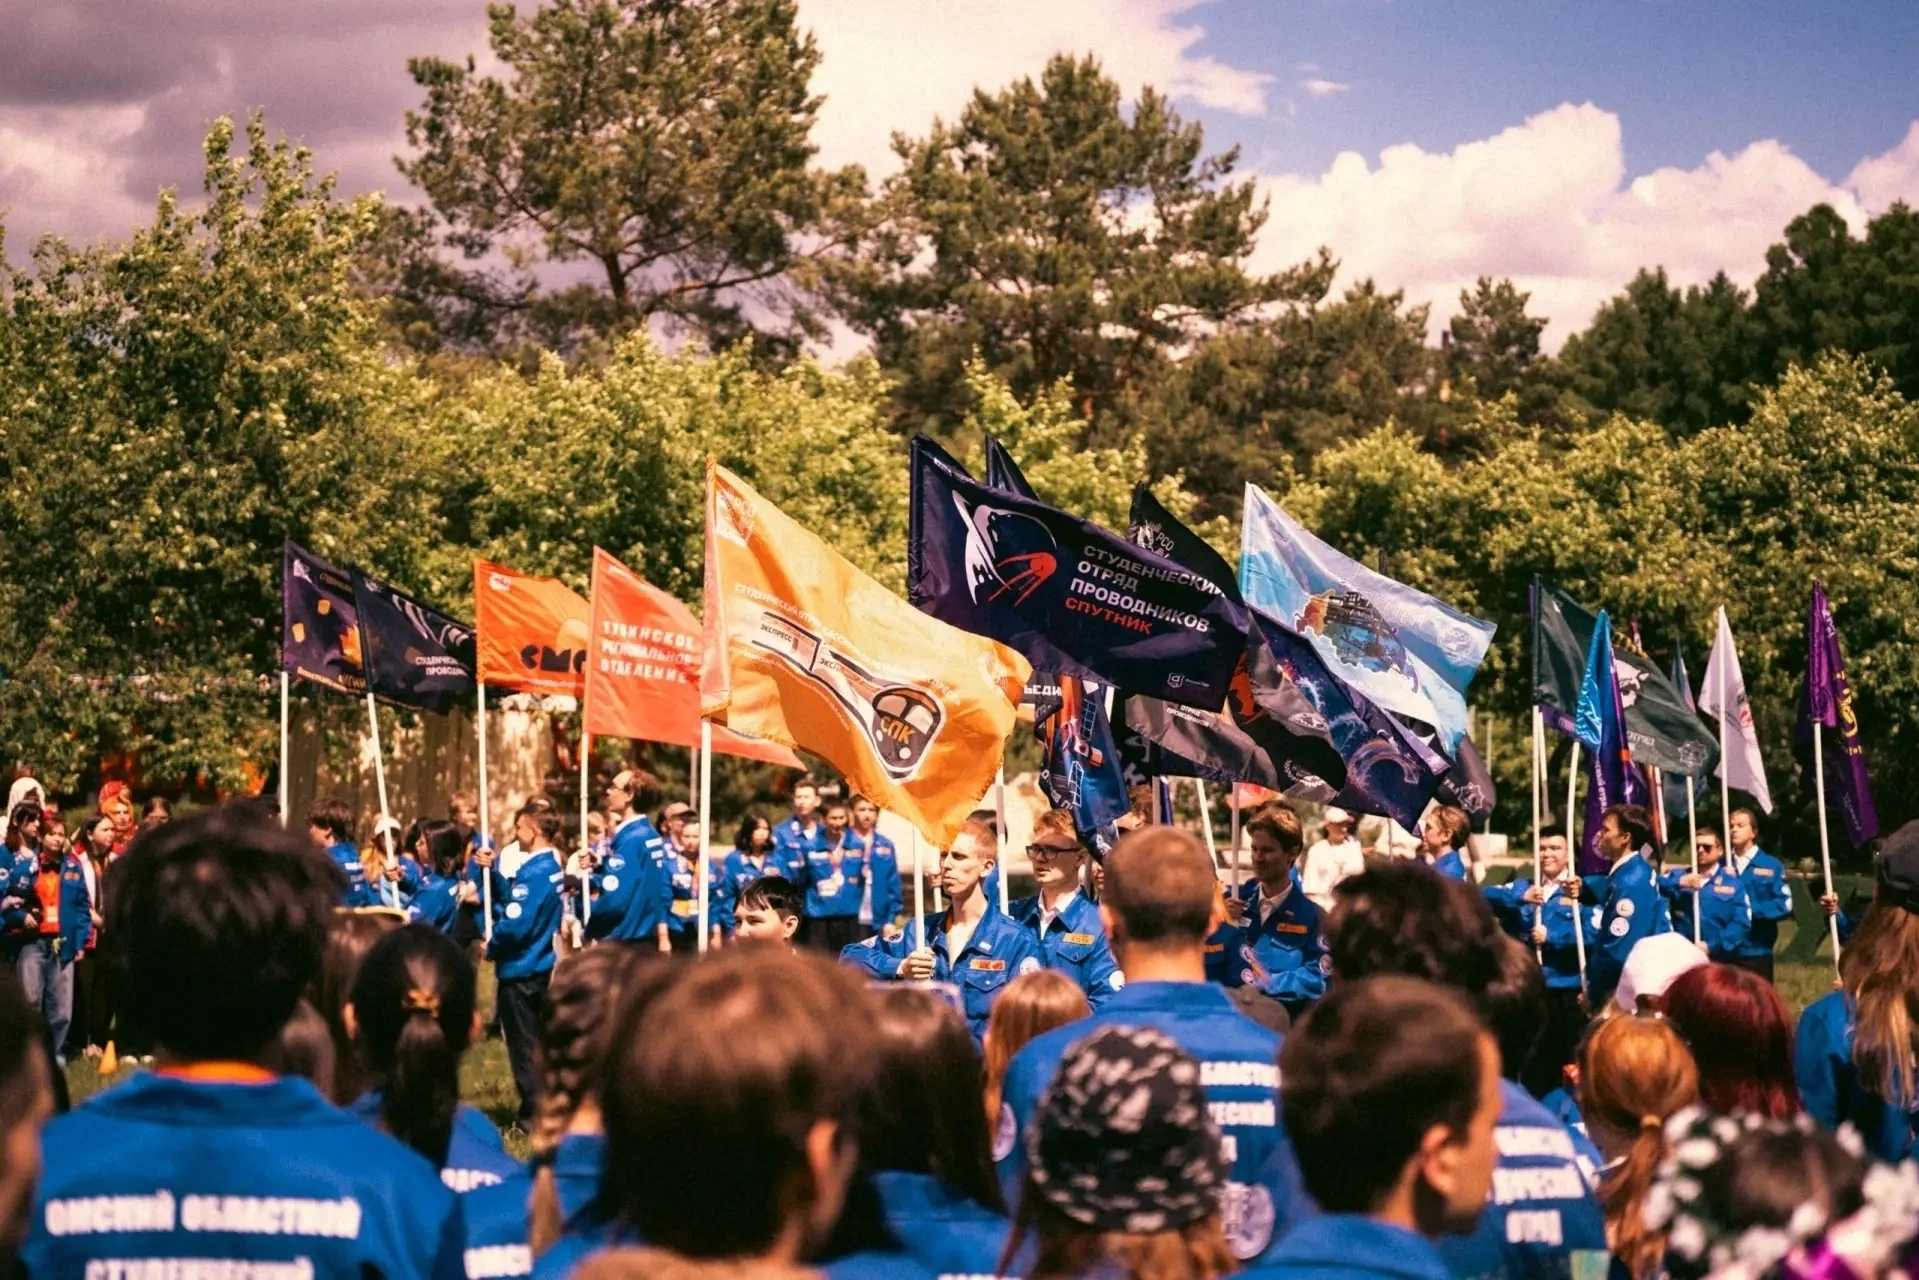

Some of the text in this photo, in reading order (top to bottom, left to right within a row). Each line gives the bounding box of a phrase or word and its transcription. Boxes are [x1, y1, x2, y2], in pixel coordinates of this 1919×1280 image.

[1156, 532, 1175, 551] РСО
[1077, 560, 1139, 593] ОТРЯД
[1083, 545, 1226, 598] СТУДЕНЧЕСКИЙ
[1064, 597, 1153, 635] СПУТНИК
[1069, 577, 1211, 633] ПРОВОДНИКОВ
[760, 623, 792, 643] ЭКСПРЕСС
[880, 716, 916, 745] СПК
